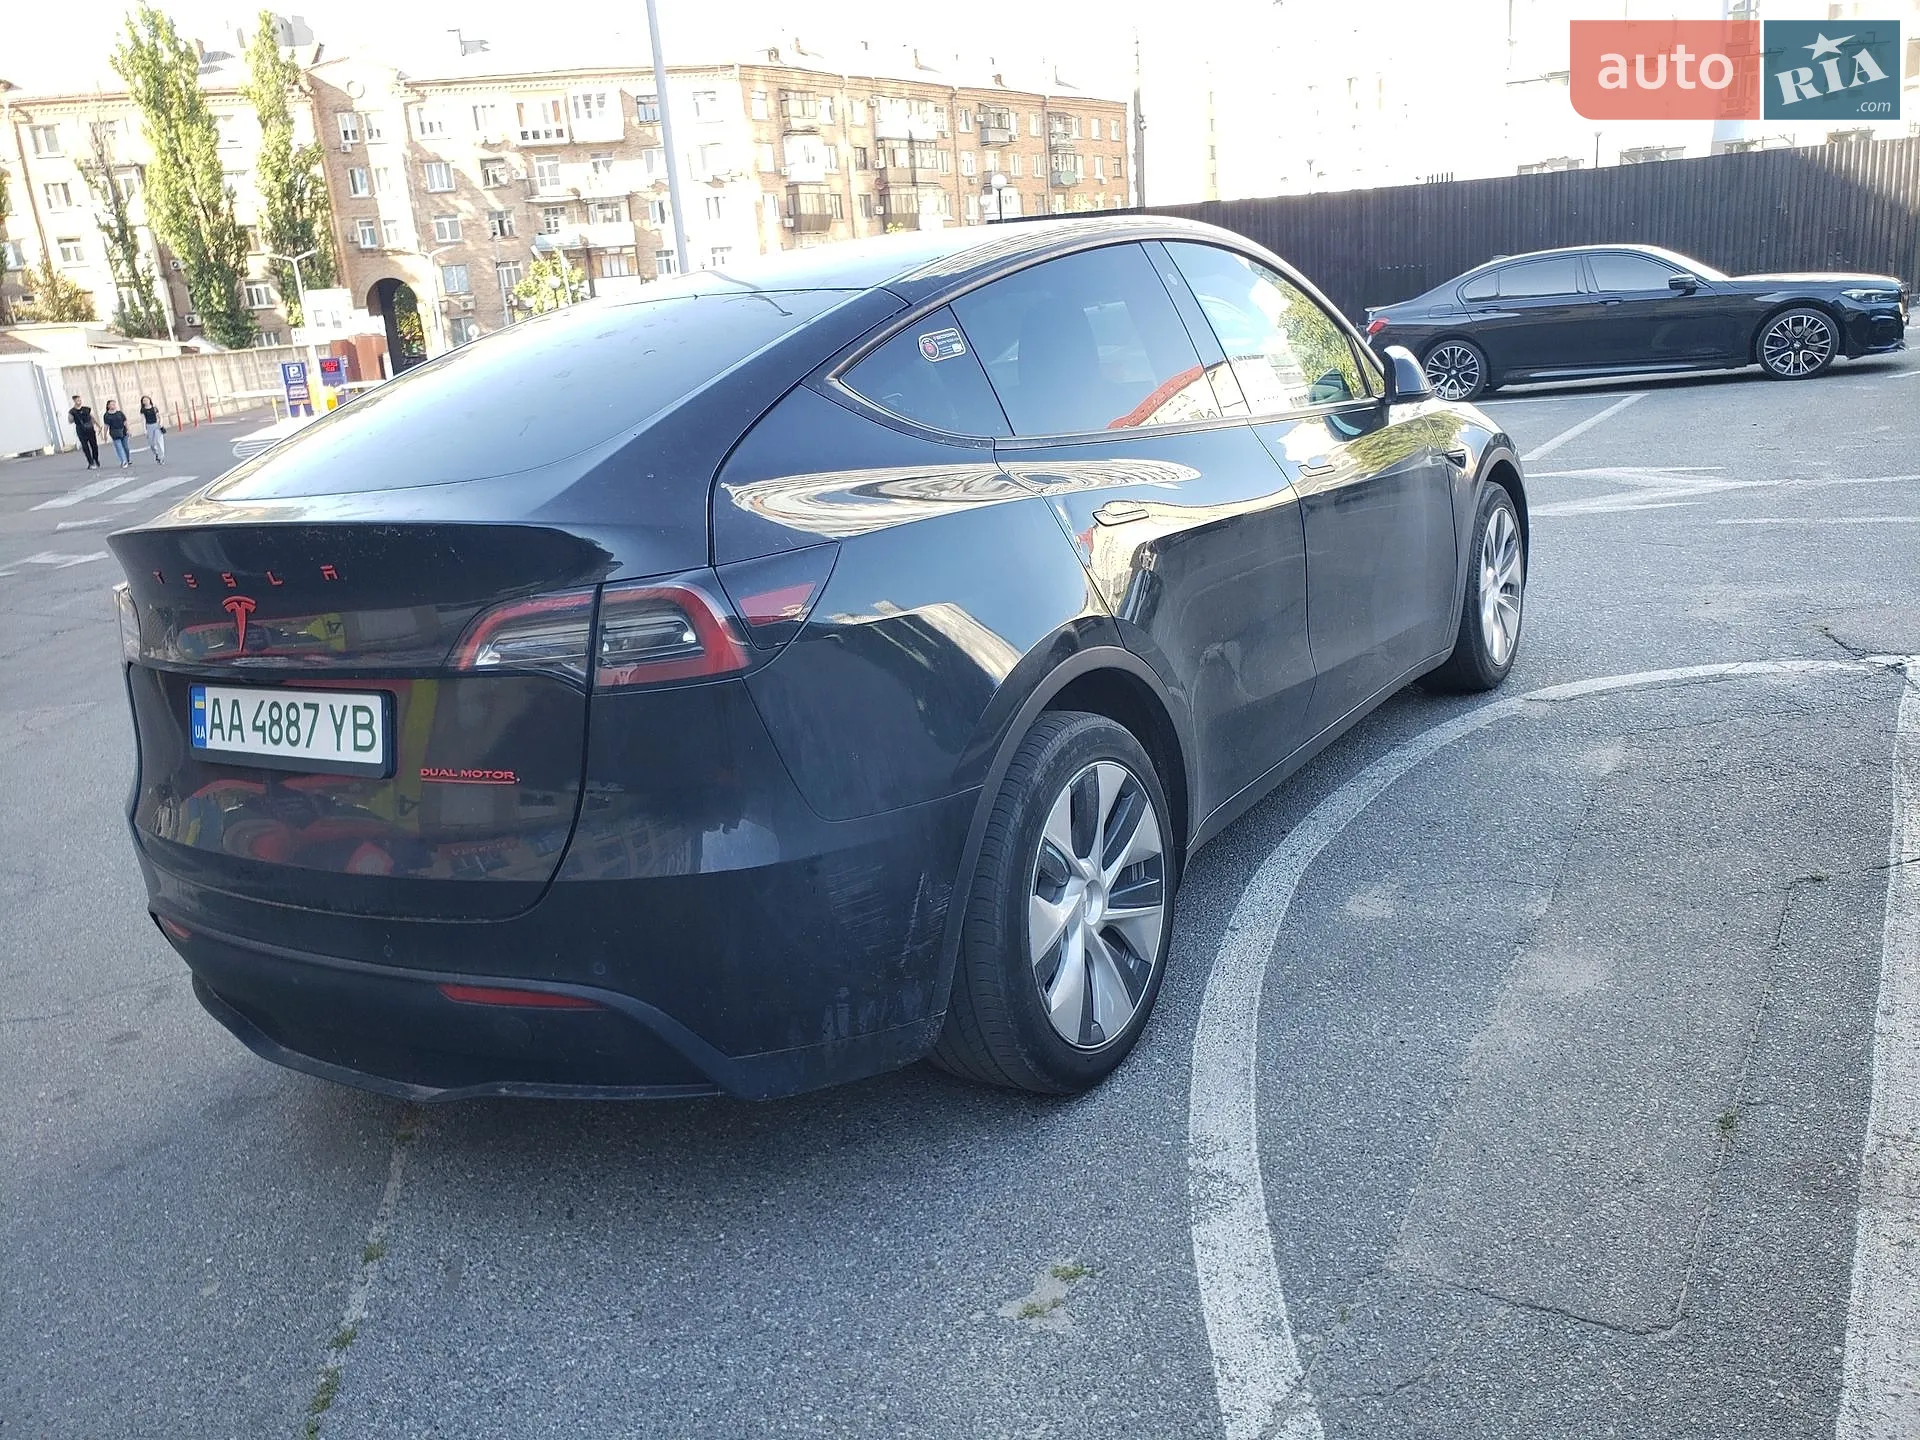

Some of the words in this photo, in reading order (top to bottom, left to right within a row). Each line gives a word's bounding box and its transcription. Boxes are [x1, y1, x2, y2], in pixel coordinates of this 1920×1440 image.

[289, 366, 300, 378] P
[152, 564, 338, 589] TESLA
[209, 698, 245, 743] AA
[252, 700, 319, 748] 4887
[329, 704, 376, 753] YB
[195, 727, 206, 739] UA
[420, 768, 458, 777] DUAL
[460, 769, 515, 780] MOTOR
